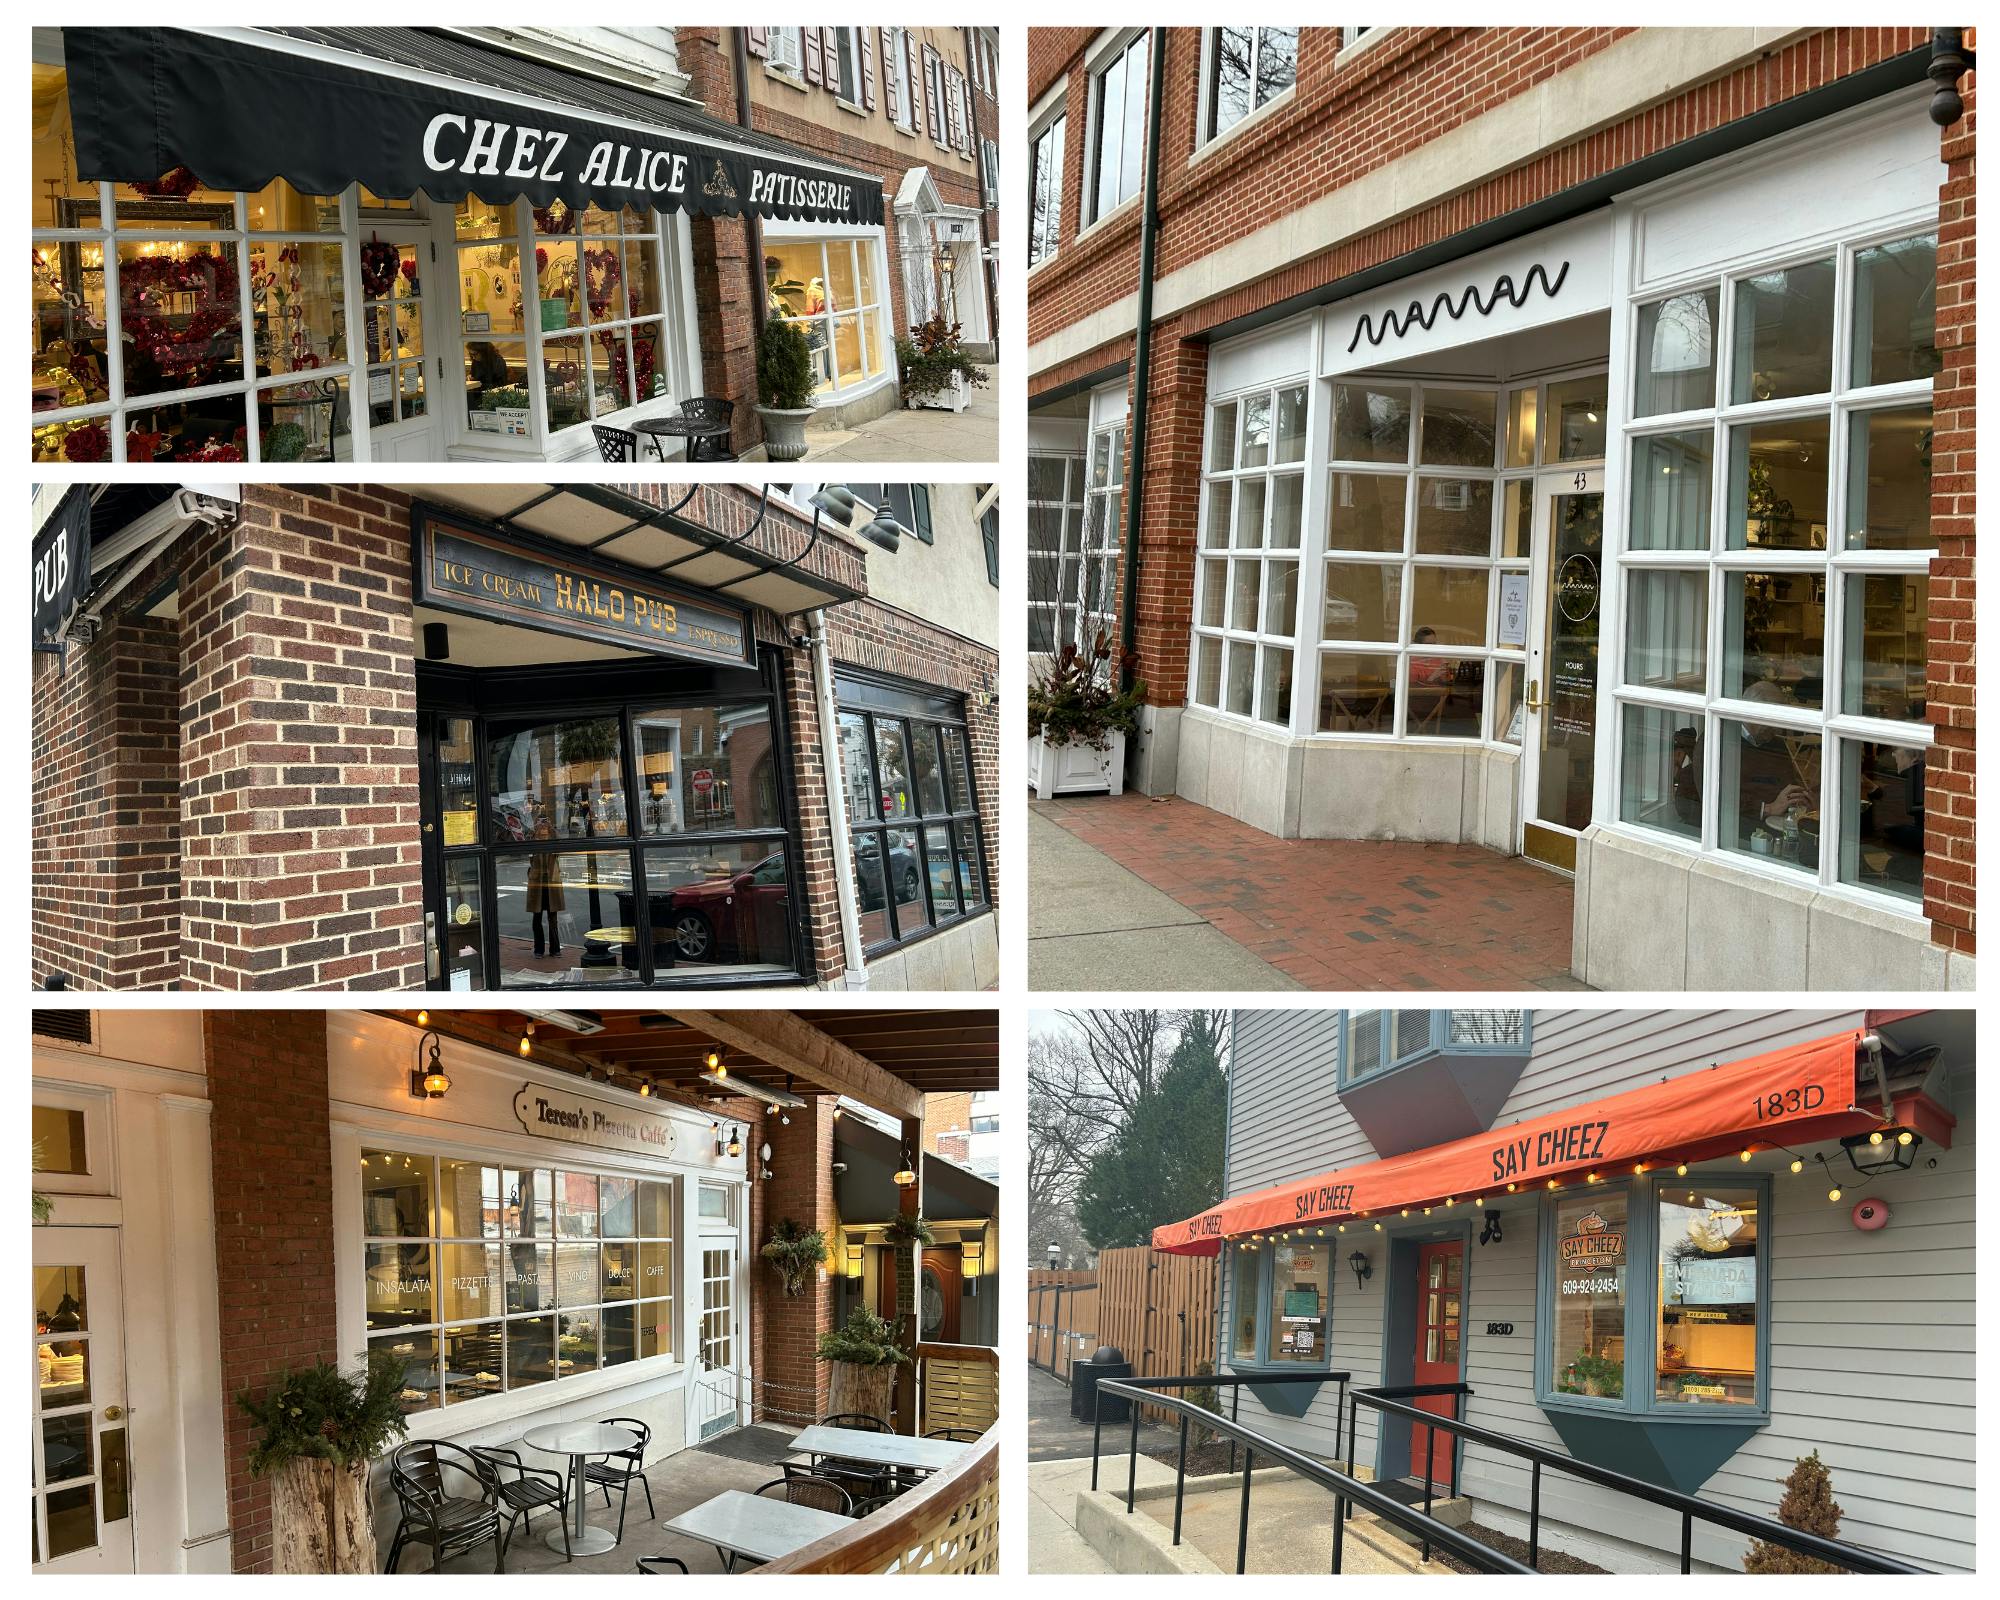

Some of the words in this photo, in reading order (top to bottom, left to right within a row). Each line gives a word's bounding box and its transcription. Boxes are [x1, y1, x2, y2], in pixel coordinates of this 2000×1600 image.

[423, 113, 569, 182] CHEZ
[578, 141, 688, 193] ALICE
[750, 169, 852, 211] PATISSERIE
[1348, 261, 1569, 353] MAMAN
[1574, 472, 1586, 490] 43
[34, 527, 68, 617] PUB
[444, 561, 474, 586] ICE
[482, 572, 541, 604] CREAM
[555, 573, 625, 622] HALO
[633, 595, 678, 633] PUB
[688, 625, 738, 648] ESPRESSO
[1565, 661, 1584, 670] HOURS
[536, 1097, 588, 1130] Teresa's
[593, 1111, 637, 1141] Pizzetta
[1753, 1085, 1825, 1120] 183D
[1493, 1138, 1531, 1182] SAY
[1537, 1121, 1609, 1167] CHEEZ
[1296, 1190, 1317, 1219] SAY
[1318, 1185, 1355, 1212] CHEEZ
[1189, 1219, 1200, 1240] SAY
[1201, 1215, 1223, 1235] CHEEZ
[1564, 1239, 1584, 1258] SAY
[1587, 1236, 1619, 1254] CHEEZ
[1571, 1256, 1612, 1266] PRINCETON
[376, 1279, 432, 1294] INSALATA
[517, 1273, 542, 1286] PASTA
[608, 1268, 630, 1279] DOLCE
[1562, 1278, 1618, 1294] 609-924-2454
[1486, 1322, 1514, 1335] 183D
